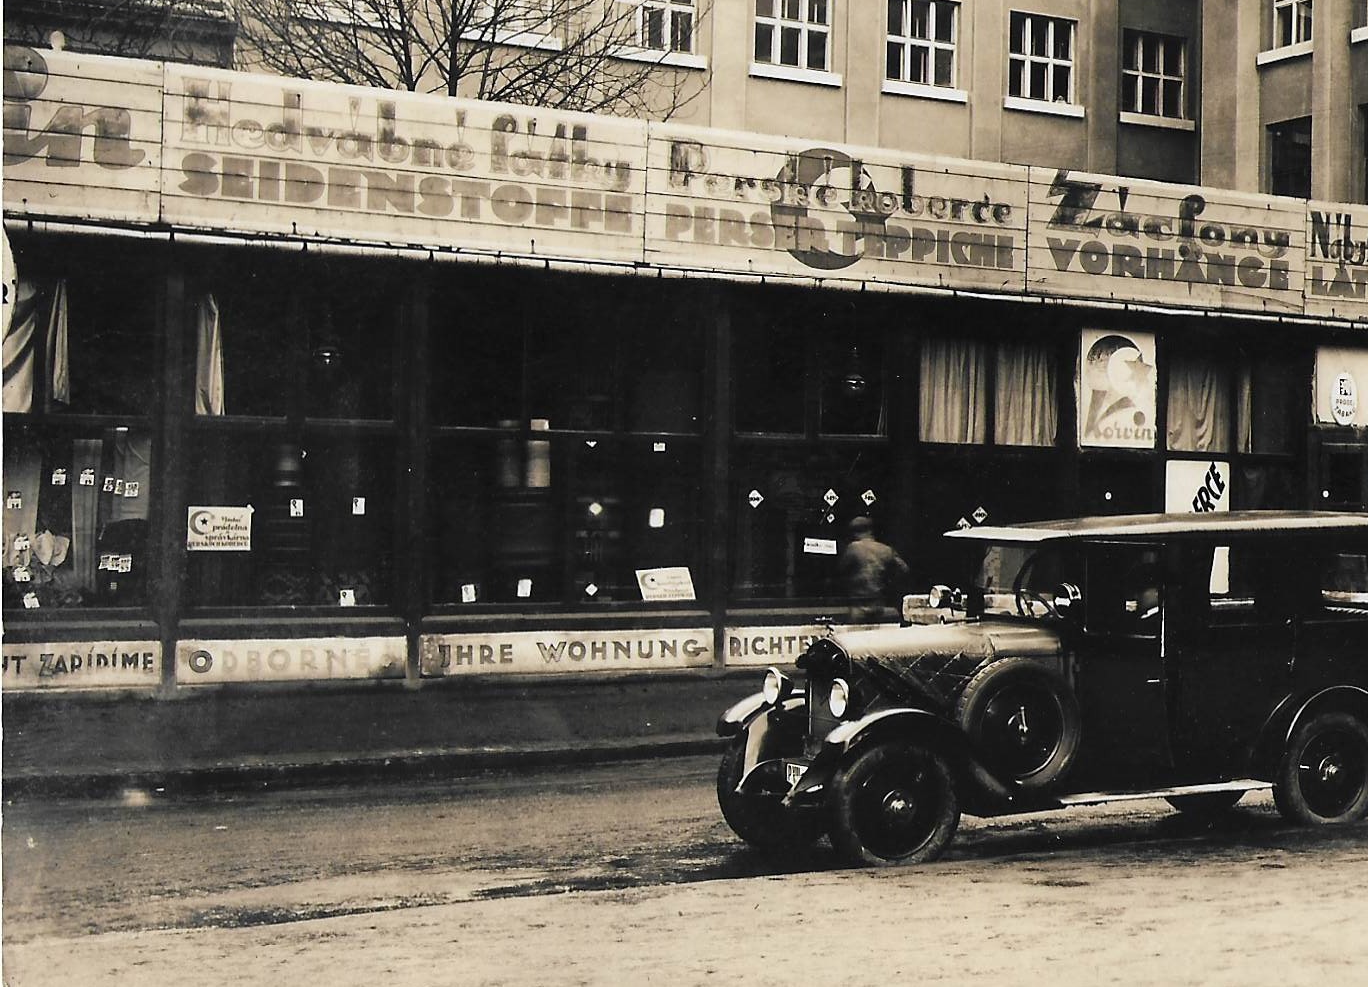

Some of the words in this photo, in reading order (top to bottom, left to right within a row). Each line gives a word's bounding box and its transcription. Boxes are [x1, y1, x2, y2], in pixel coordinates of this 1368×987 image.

[178, 151, 634, 233] SEIDENSTOFFE
[1046, 169, 1292, 260] Záclony
[729, 634, 824, 657] RICHTE
